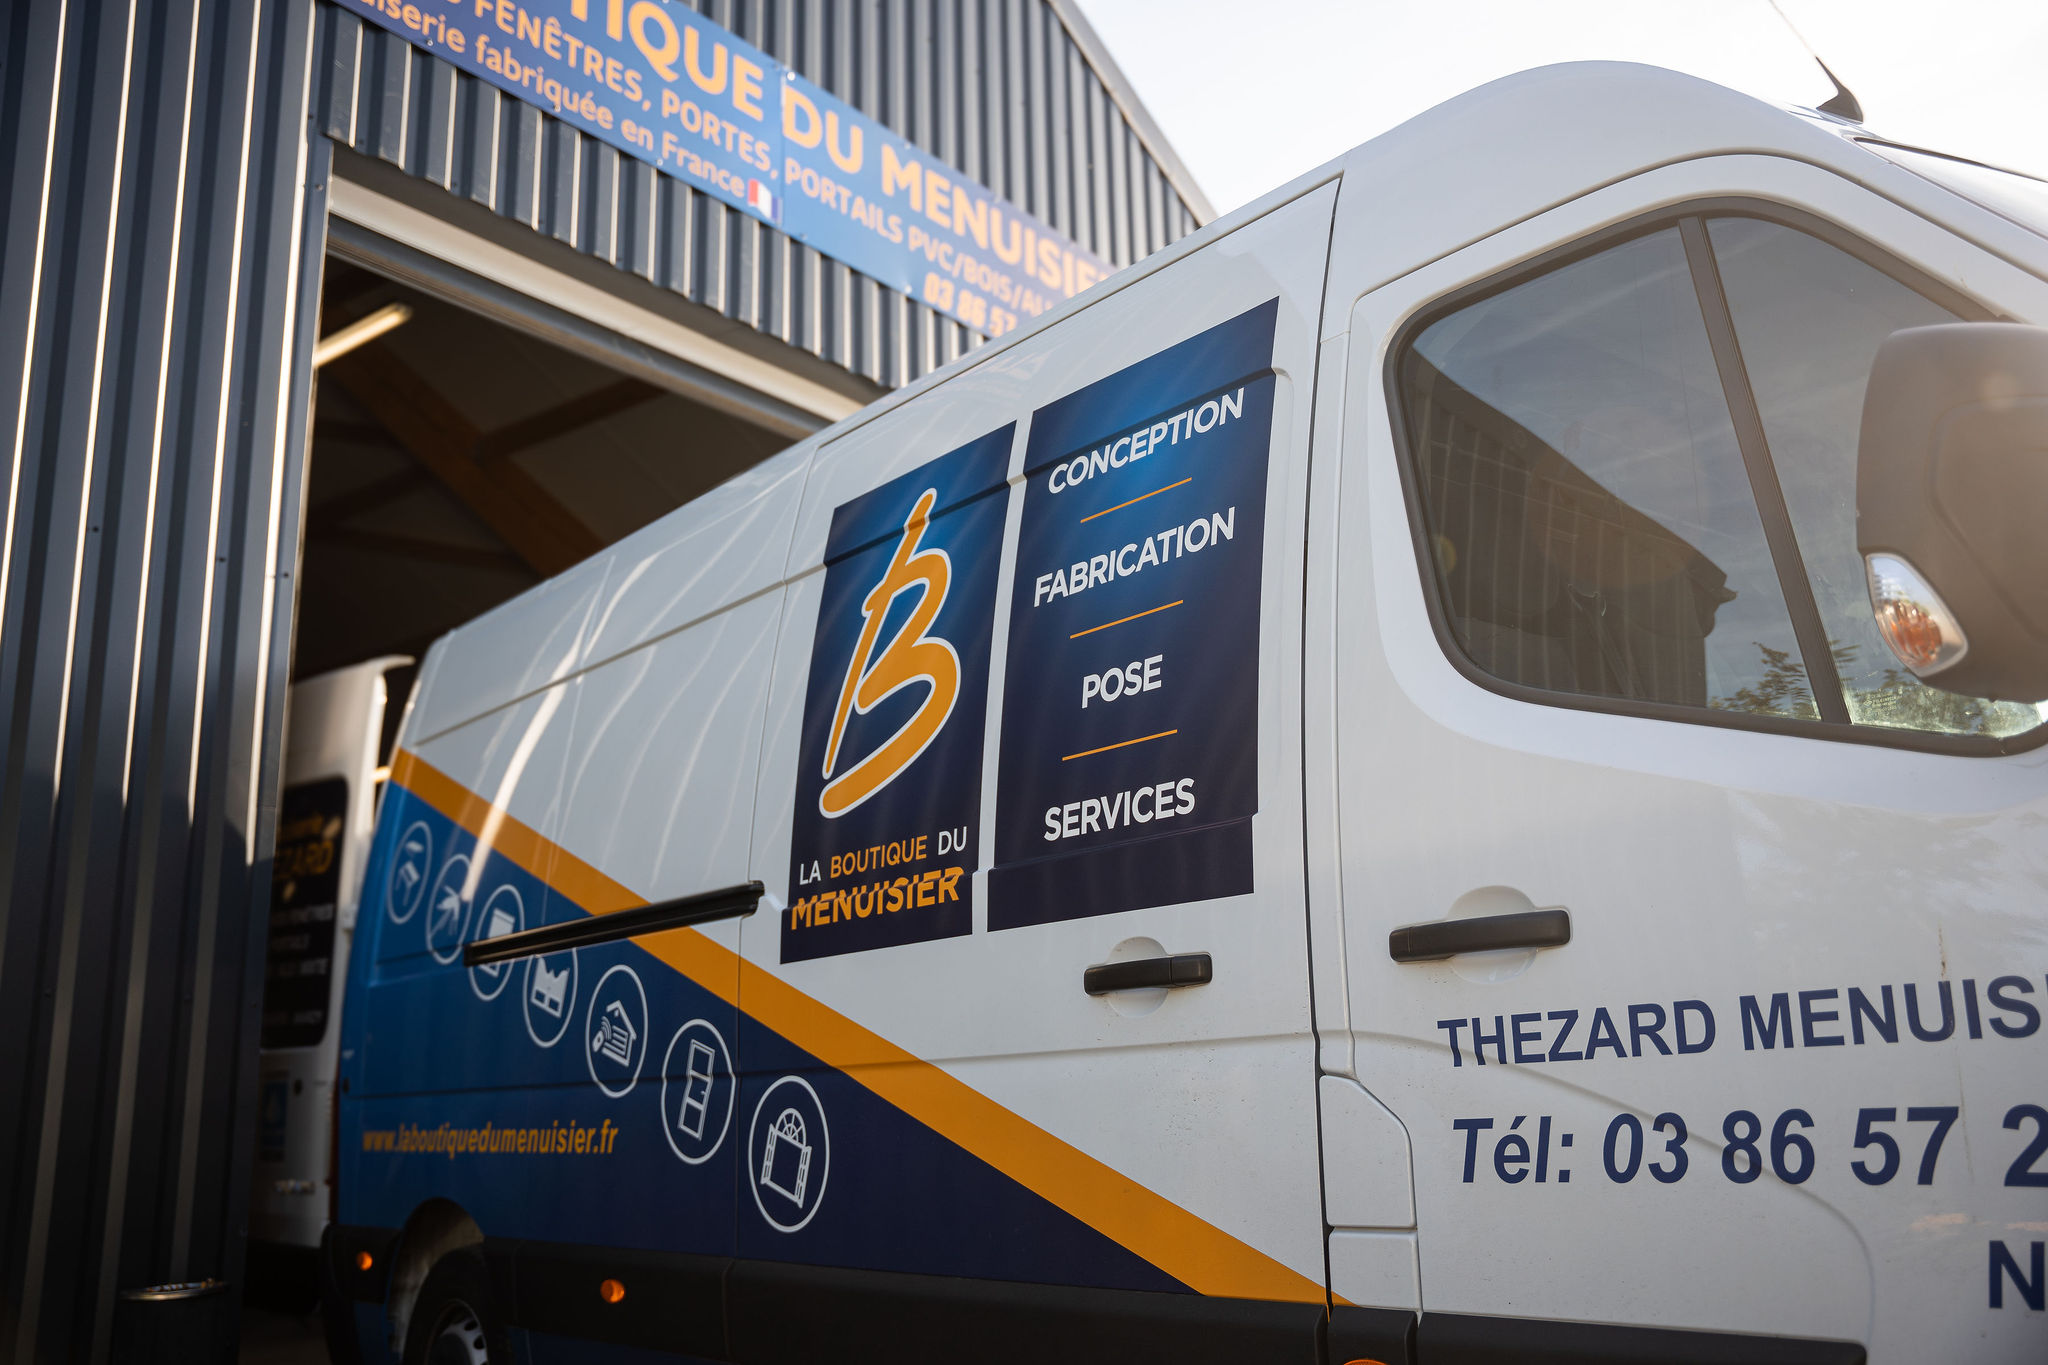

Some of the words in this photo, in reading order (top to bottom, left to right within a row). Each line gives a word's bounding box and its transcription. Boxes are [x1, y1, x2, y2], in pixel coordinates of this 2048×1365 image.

[475, 34, 614, 130] fabriquée
[620, 118, 655, 151] en
[661, 130, 746, 199] France
[661, 88, 779, 181] PORTES,
[784, 156, 904, 248] PORTAILS
[908, 225, 1053, 318] PVC/BOIS/AL
[783, 85, 864, 175] DU
[881, 143, 1109, 298] MENUISIE
[924, 271, 955, 312] 03
[956, 289, 988, 330] 86
[1047, 386, 1246, 495] CONCEPTION
[1033, 506, 1237, 608] FABRICATION
[1080, 653, 1164, 709] POSE
[1043, 777, 1197, 843] SERVICES
[799, 862, 823, 886] LA
[830, 834, 929, 879] BOUTIQUE
[937, 825, 969, 857] DU
[790, 865, 965, 931] MENUISIER
[1436, 998, 1717, 1068] THEZARD
[1738, 973, 2048, 1052] MENUIS
[362, 1118, 619, 1160] www.laboutiquedumenuisier.fr
[1452, 1112, 1575, 1185] Tél:
[1602, 1112, 1690, 1185] 03
[1721, 1109, 1817, 1185] 86
[1850, 1106, 1960, 1187] 57
[2002, 1103, 2048, 1188] 2
[1988, 1239, 2047, 1312] N
